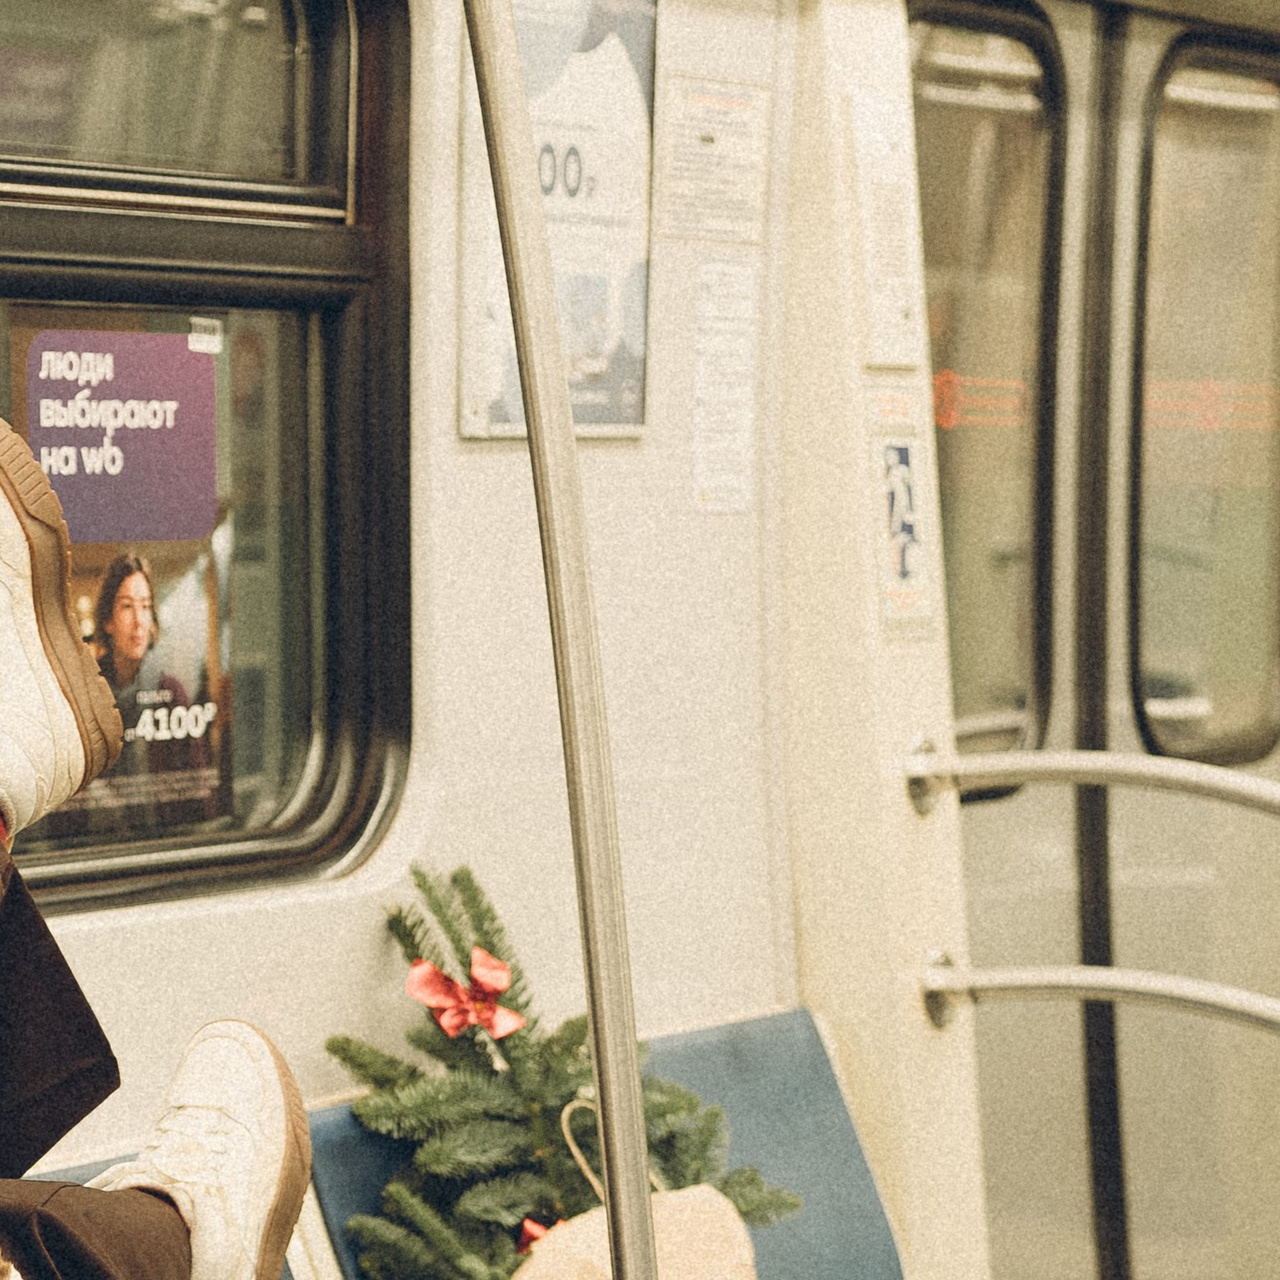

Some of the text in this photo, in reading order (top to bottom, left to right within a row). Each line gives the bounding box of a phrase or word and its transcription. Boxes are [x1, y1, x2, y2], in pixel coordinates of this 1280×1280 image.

[38, 350, 114, 387] люди
[39, 388, 179, 437] выбирают
[40, 435, 124, 476] на wb
